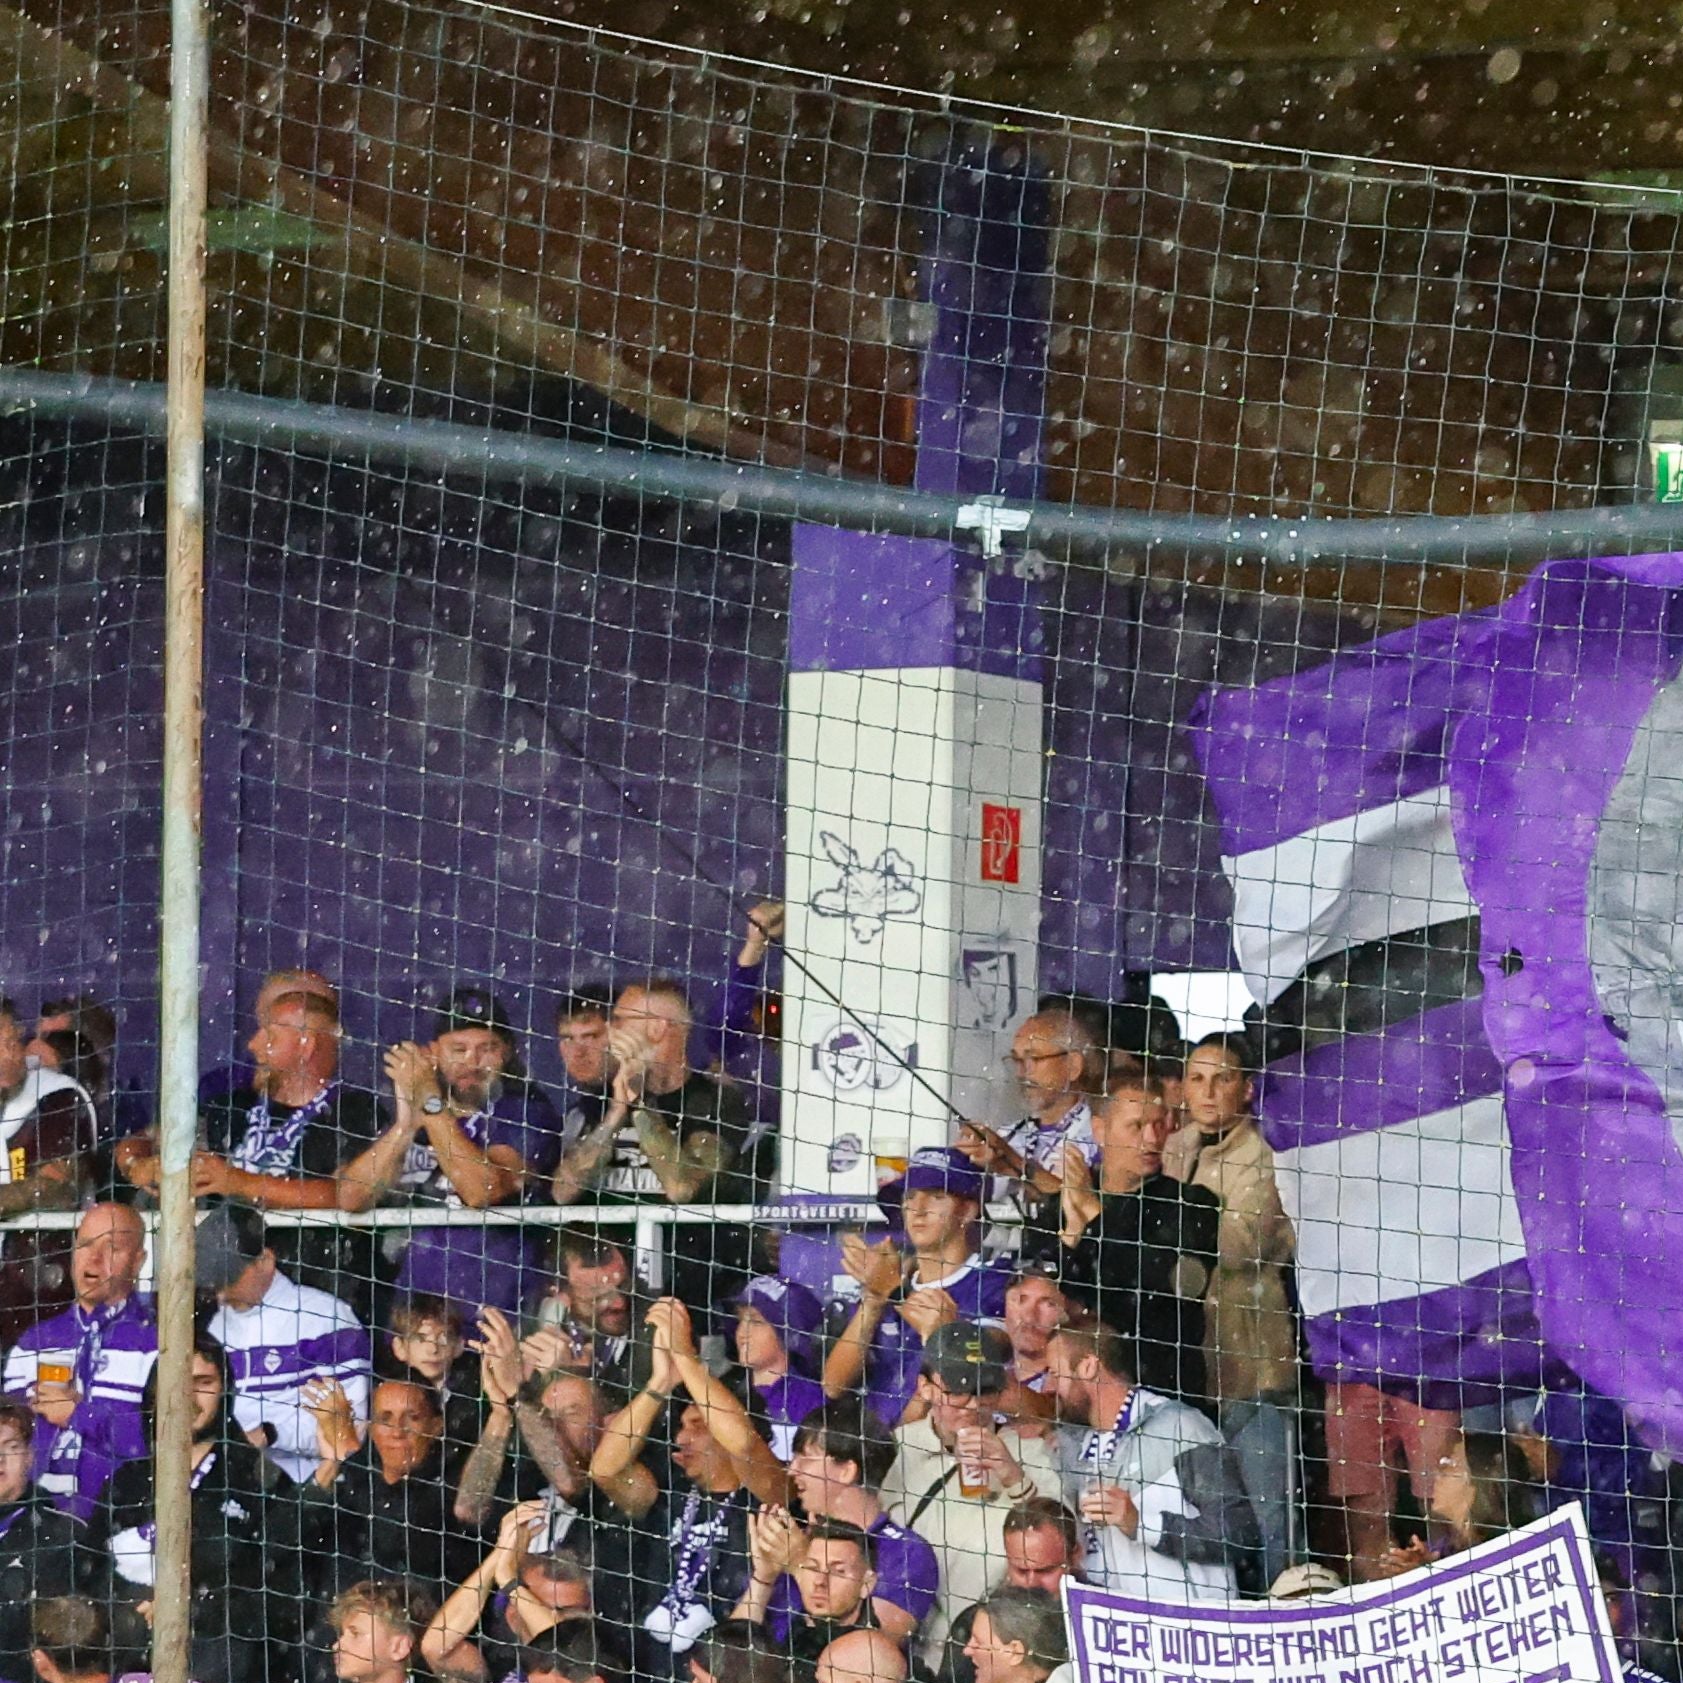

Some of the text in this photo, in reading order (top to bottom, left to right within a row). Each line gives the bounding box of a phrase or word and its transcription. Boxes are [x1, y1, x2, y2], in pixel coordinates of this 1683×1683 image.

[1092, 1552, 1566, 1668] DER WIDERSTAND GEHT WEITER
[1443, 1600, 1575, 1679] STEHEN
